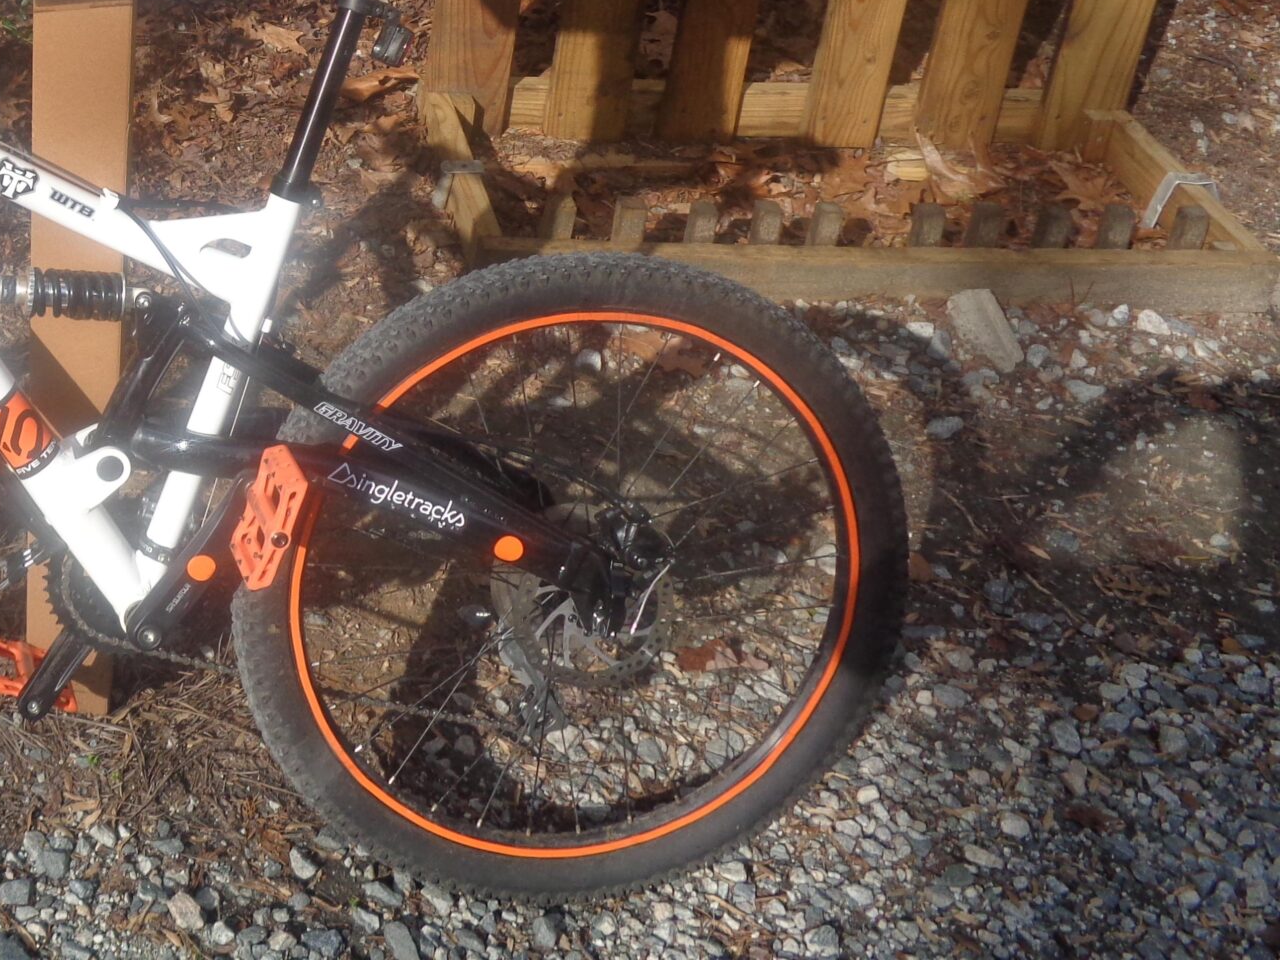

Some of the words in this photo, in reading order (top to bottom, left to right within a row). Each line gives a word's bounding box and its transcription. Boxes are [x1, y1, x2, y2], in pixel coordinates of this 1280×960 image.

[50, 187, 96, 218] WTB
[313, 401, 403, 452] GRAVITY
[342, 464, 466, 528] singletracks
